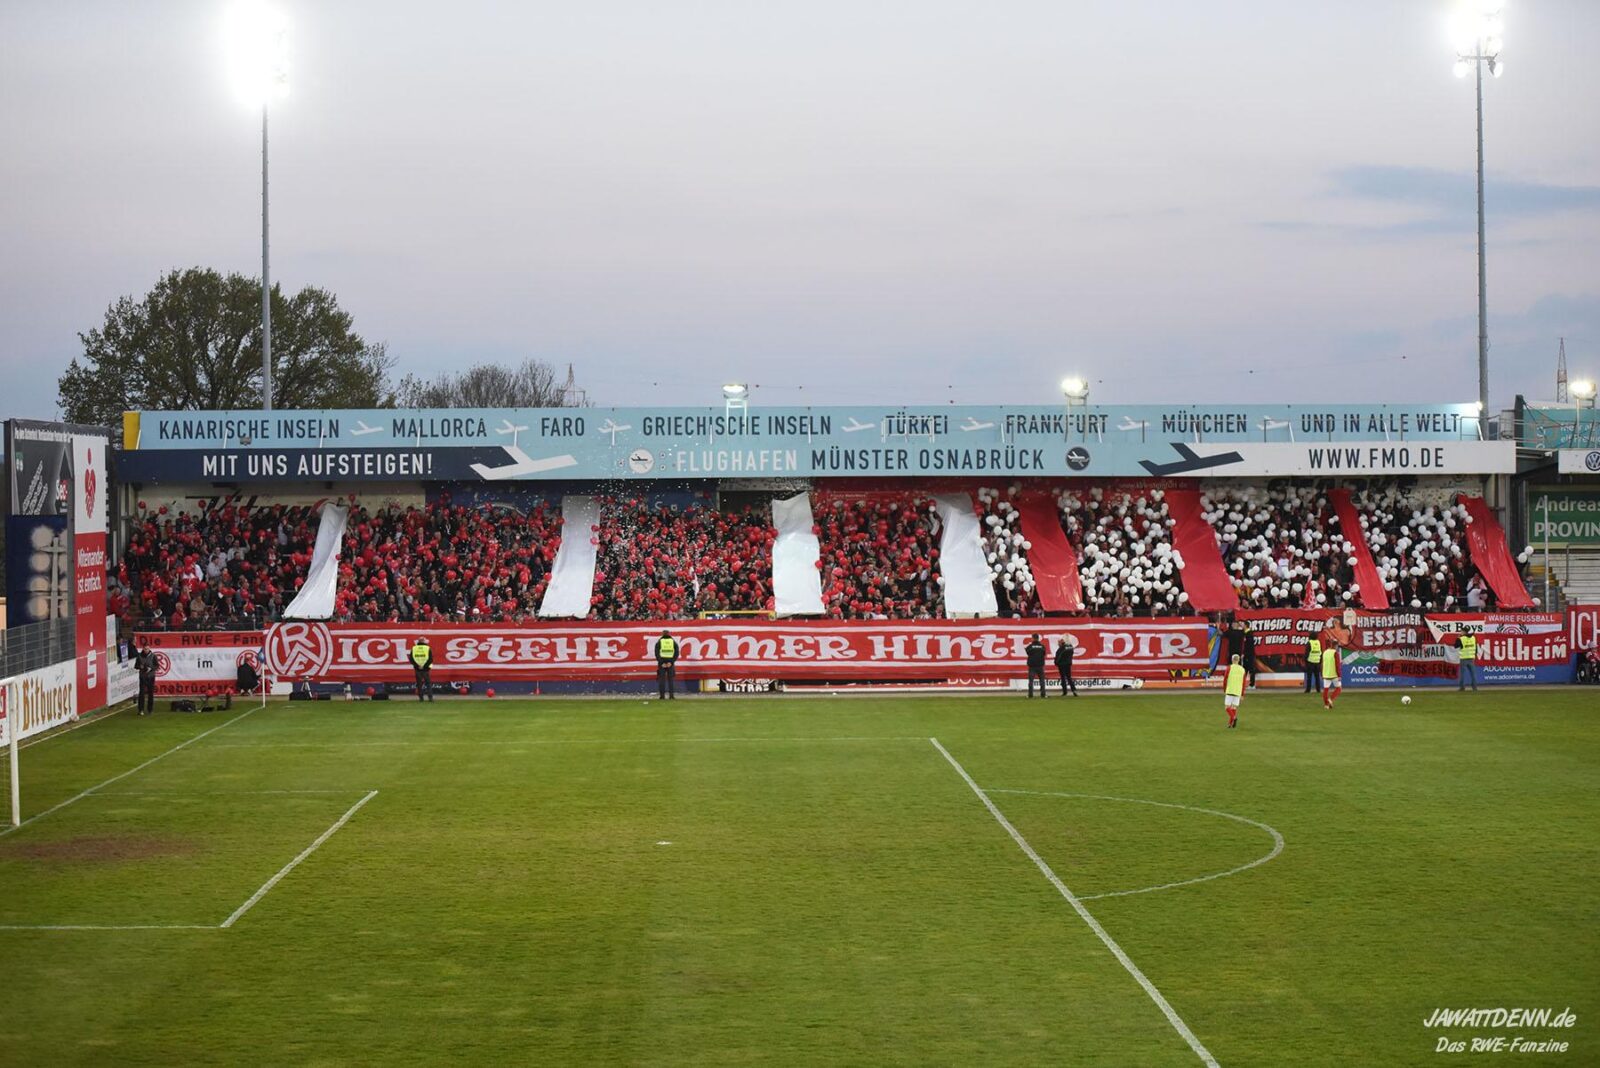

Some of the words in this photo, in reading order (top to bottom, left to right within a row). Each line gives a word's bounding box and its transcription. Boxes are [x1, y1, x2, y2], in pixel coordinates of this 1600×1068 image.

[159, 420, 270, 440] KANARISCHE
[277, 419, 340, 439] INSELN
[392, 418, 487, 438] MALLORCA
[541, 417, 585, 437] FARO
[643, 416, 760, 436] GRIECHISCHE
[768, 416, 831, 435] INSELN
[885, 412, 949, 435] TÜRKEI
[1006, 414, 1109, 435] FRANKFURT
[1162, 411, 1248, 434] MÜNCHEN
[1301, 414, 1336, 433] UND
[1343, 413, 1361, 433] IN
[1367, 413, 1410, 433] ALLE
[1416, 413, 1460, 433] WELT
[203, 455, 238, 476] MIT
[248, 455, 288, 475] UNS
[298, 453, 433, 476] AUFSTEIGEN!
[676, 450, 798, 472] FLUGHAFEN
[811, 446, 909, 471] MÜNSTER
[919, 446, 1044, 470] OSNABRÜCK
[1308, 447, 1444, 469] WWW.FMO.DE
[1296, 620, 1324, 632] CREW
[1488, 614, 1514, 622] WAHRE
[139, 635, 161, 646] Die
[182, 635, 214, 645] RWE
[1098, 632, 1197, 657] DIR
[1363, 628, 1417, 646] ESSEN
[197, 657, 213, 668] im
[22, 676, 73, 731] Bitburger
